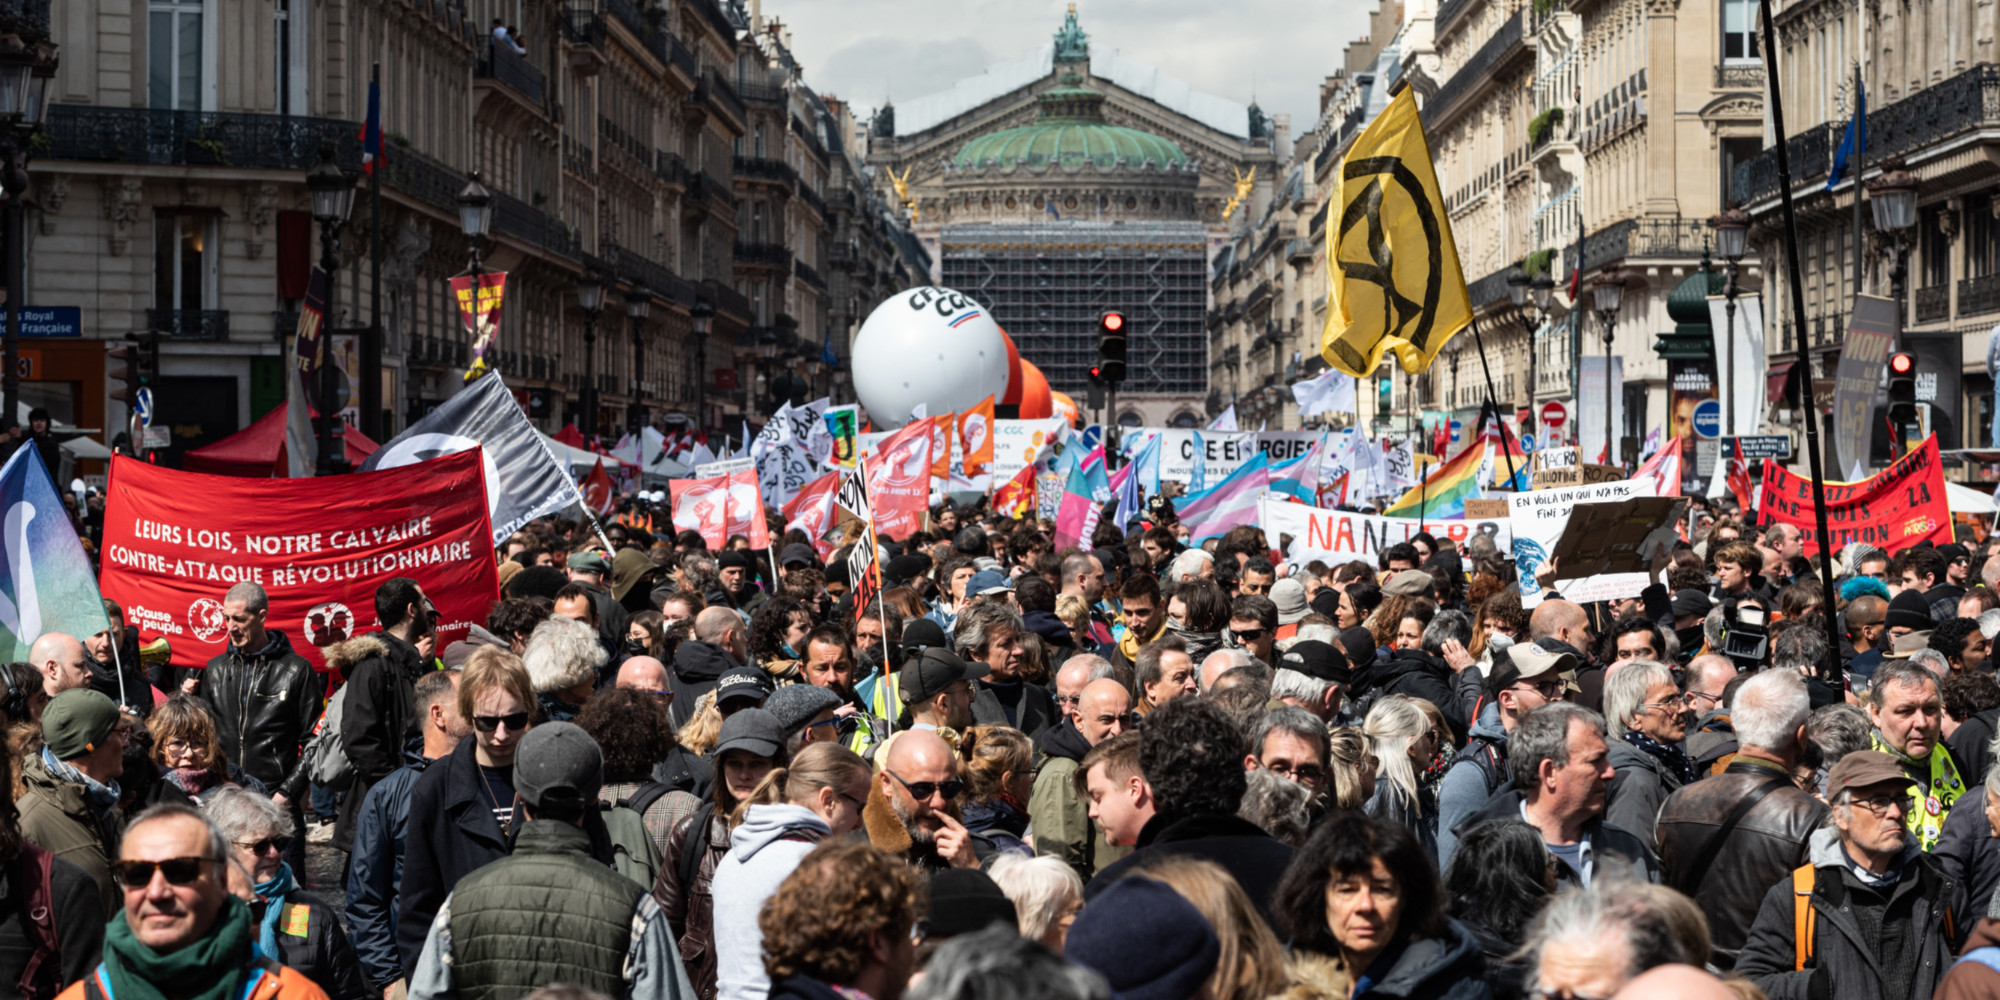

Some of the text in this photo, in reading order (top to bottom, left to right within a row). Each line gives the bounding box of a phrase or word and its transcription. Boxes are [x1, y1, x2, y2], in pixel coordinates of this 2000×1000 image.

[21, 322, 73, 335] Française
[24, 310, 54, 323] Royal
[1181, 438, 1217, 462] CE
[838, 460, 869, 516] NON
[1767, 465, 1786, 491] IL
[1797, 480, 1857, 501] EAIT
[1515, 498, 1530, 508] EN
[1533, 494, 1559, 506] VOILÀ
[1560, 491, 1573, 502] UN
[1576, 488, 1591, 500] QUI
[1613, 486, 1630, 496] PAS
[1766, 489, 1800, 518] UNE
[1907, 482, 1932, 507] LA
[1537, 508, 1556, 519] FINI
[135, 516, 432, 555] LEURS LOIS, NOTRE CALVAIRE
[110, 541, 472, 586] CONTRE-ATTAQUE RÉVOLUTIONNAIRE
[849, 525, 874, 588] NON
[136, 605, 171, 623] Cause
[142, 618, 183, 635] peuple
